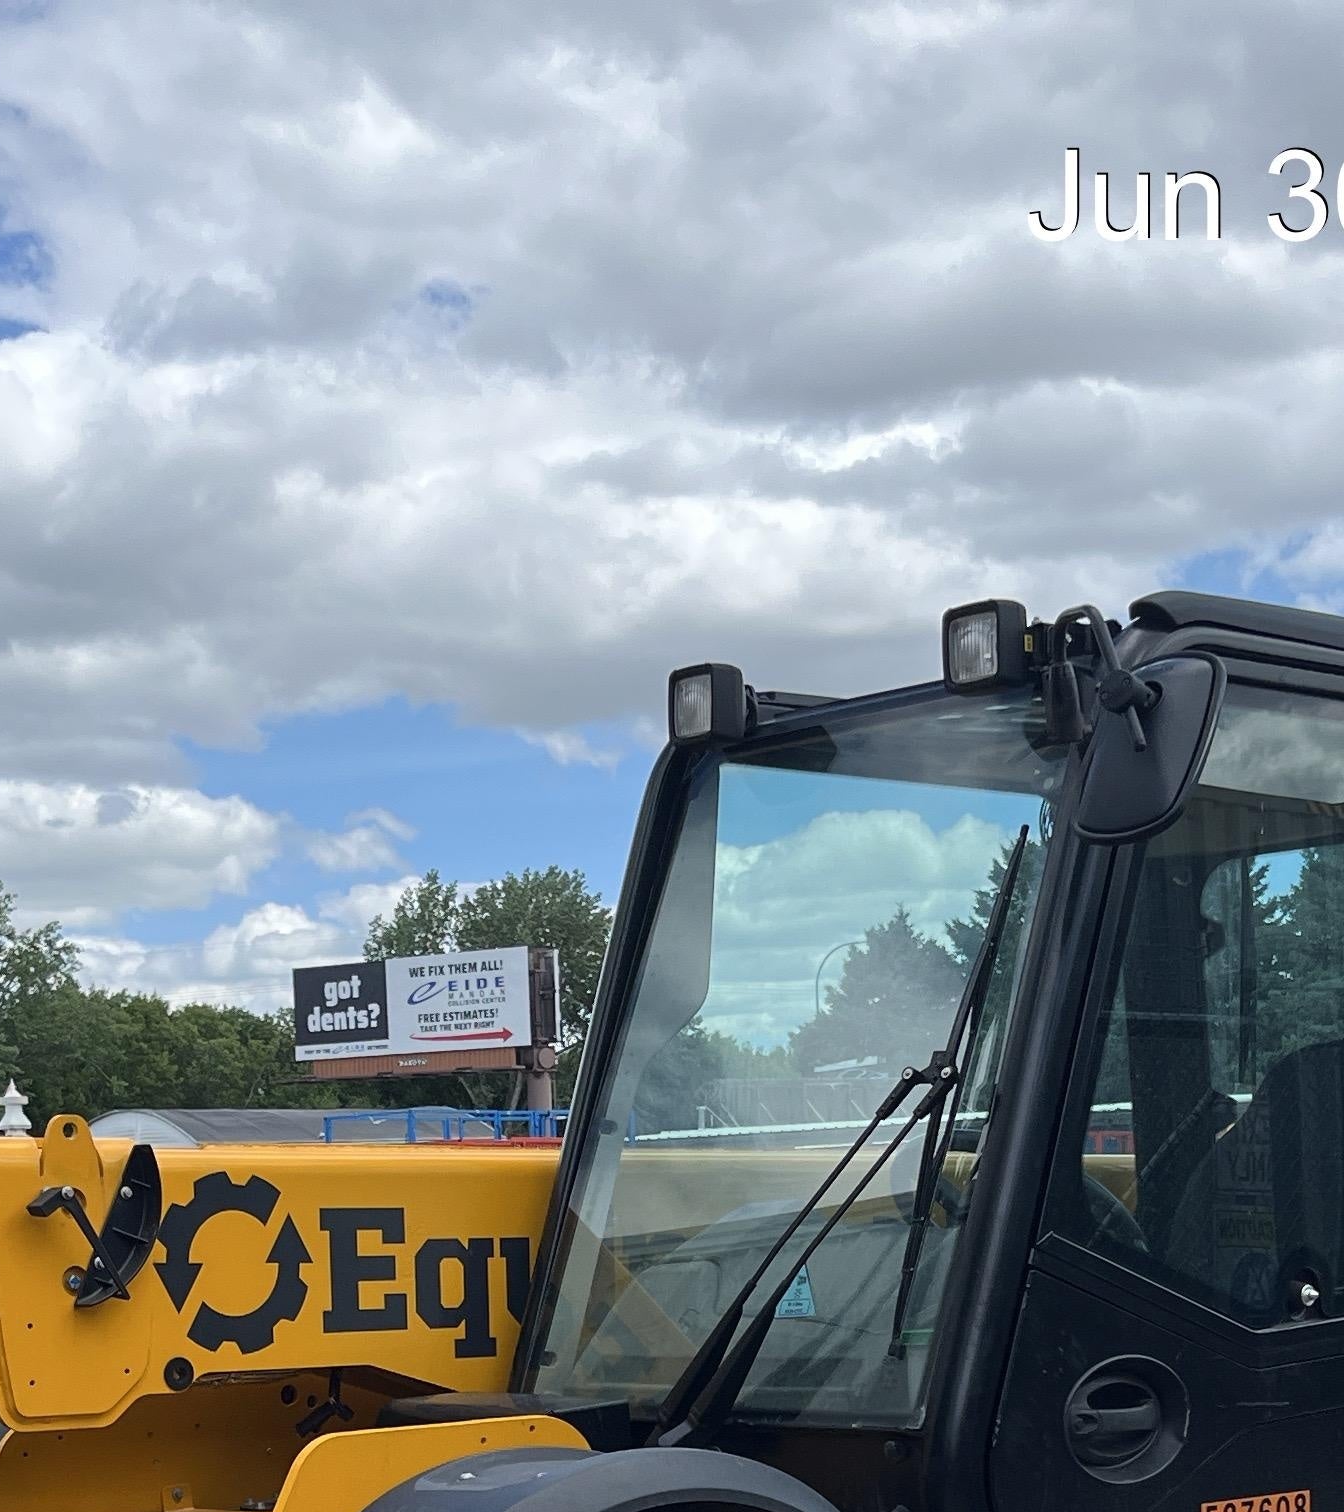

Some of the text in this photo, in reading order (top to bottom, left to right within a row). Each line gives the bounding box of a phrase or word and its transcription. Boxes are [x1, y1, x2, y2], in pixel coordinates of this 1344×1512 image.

[408, 960, 503, 978] WE FIX THEM ALL!
[324, 975, 361, 1007] got
[448, 976, 505, 991] EIDE
[448, 989, 506, 999] MANDAN
[307, 1003, 380, 1033] dents?
[417, 1008, 498, 1023] FREE ESTIMATES!
